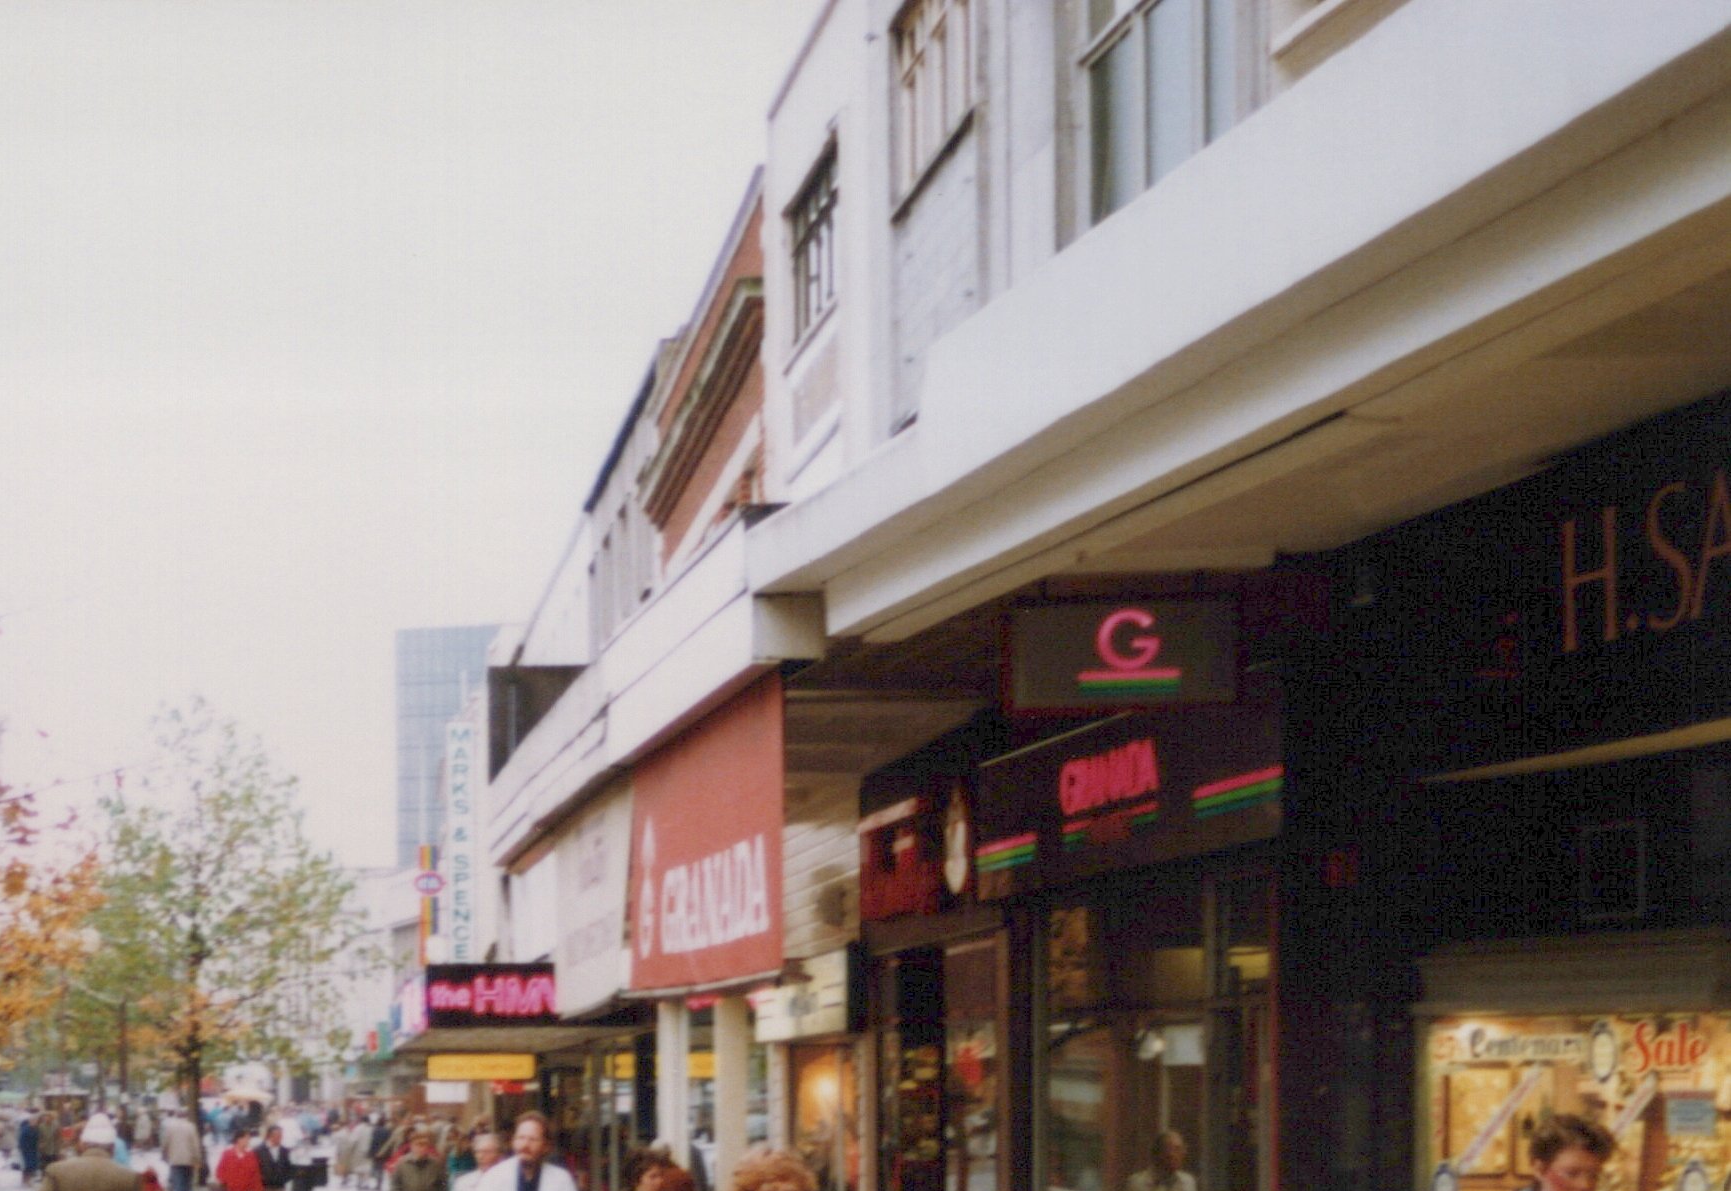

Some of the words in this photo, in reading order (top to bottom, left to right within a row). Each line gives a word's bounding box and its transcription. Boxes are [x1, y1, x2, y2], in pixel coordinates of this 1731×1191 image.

[451, 727, 471, 816] MARKS
[661, 833, 770, 956] GRANADA
[1632, 1022, 1709, 1074] Sale
